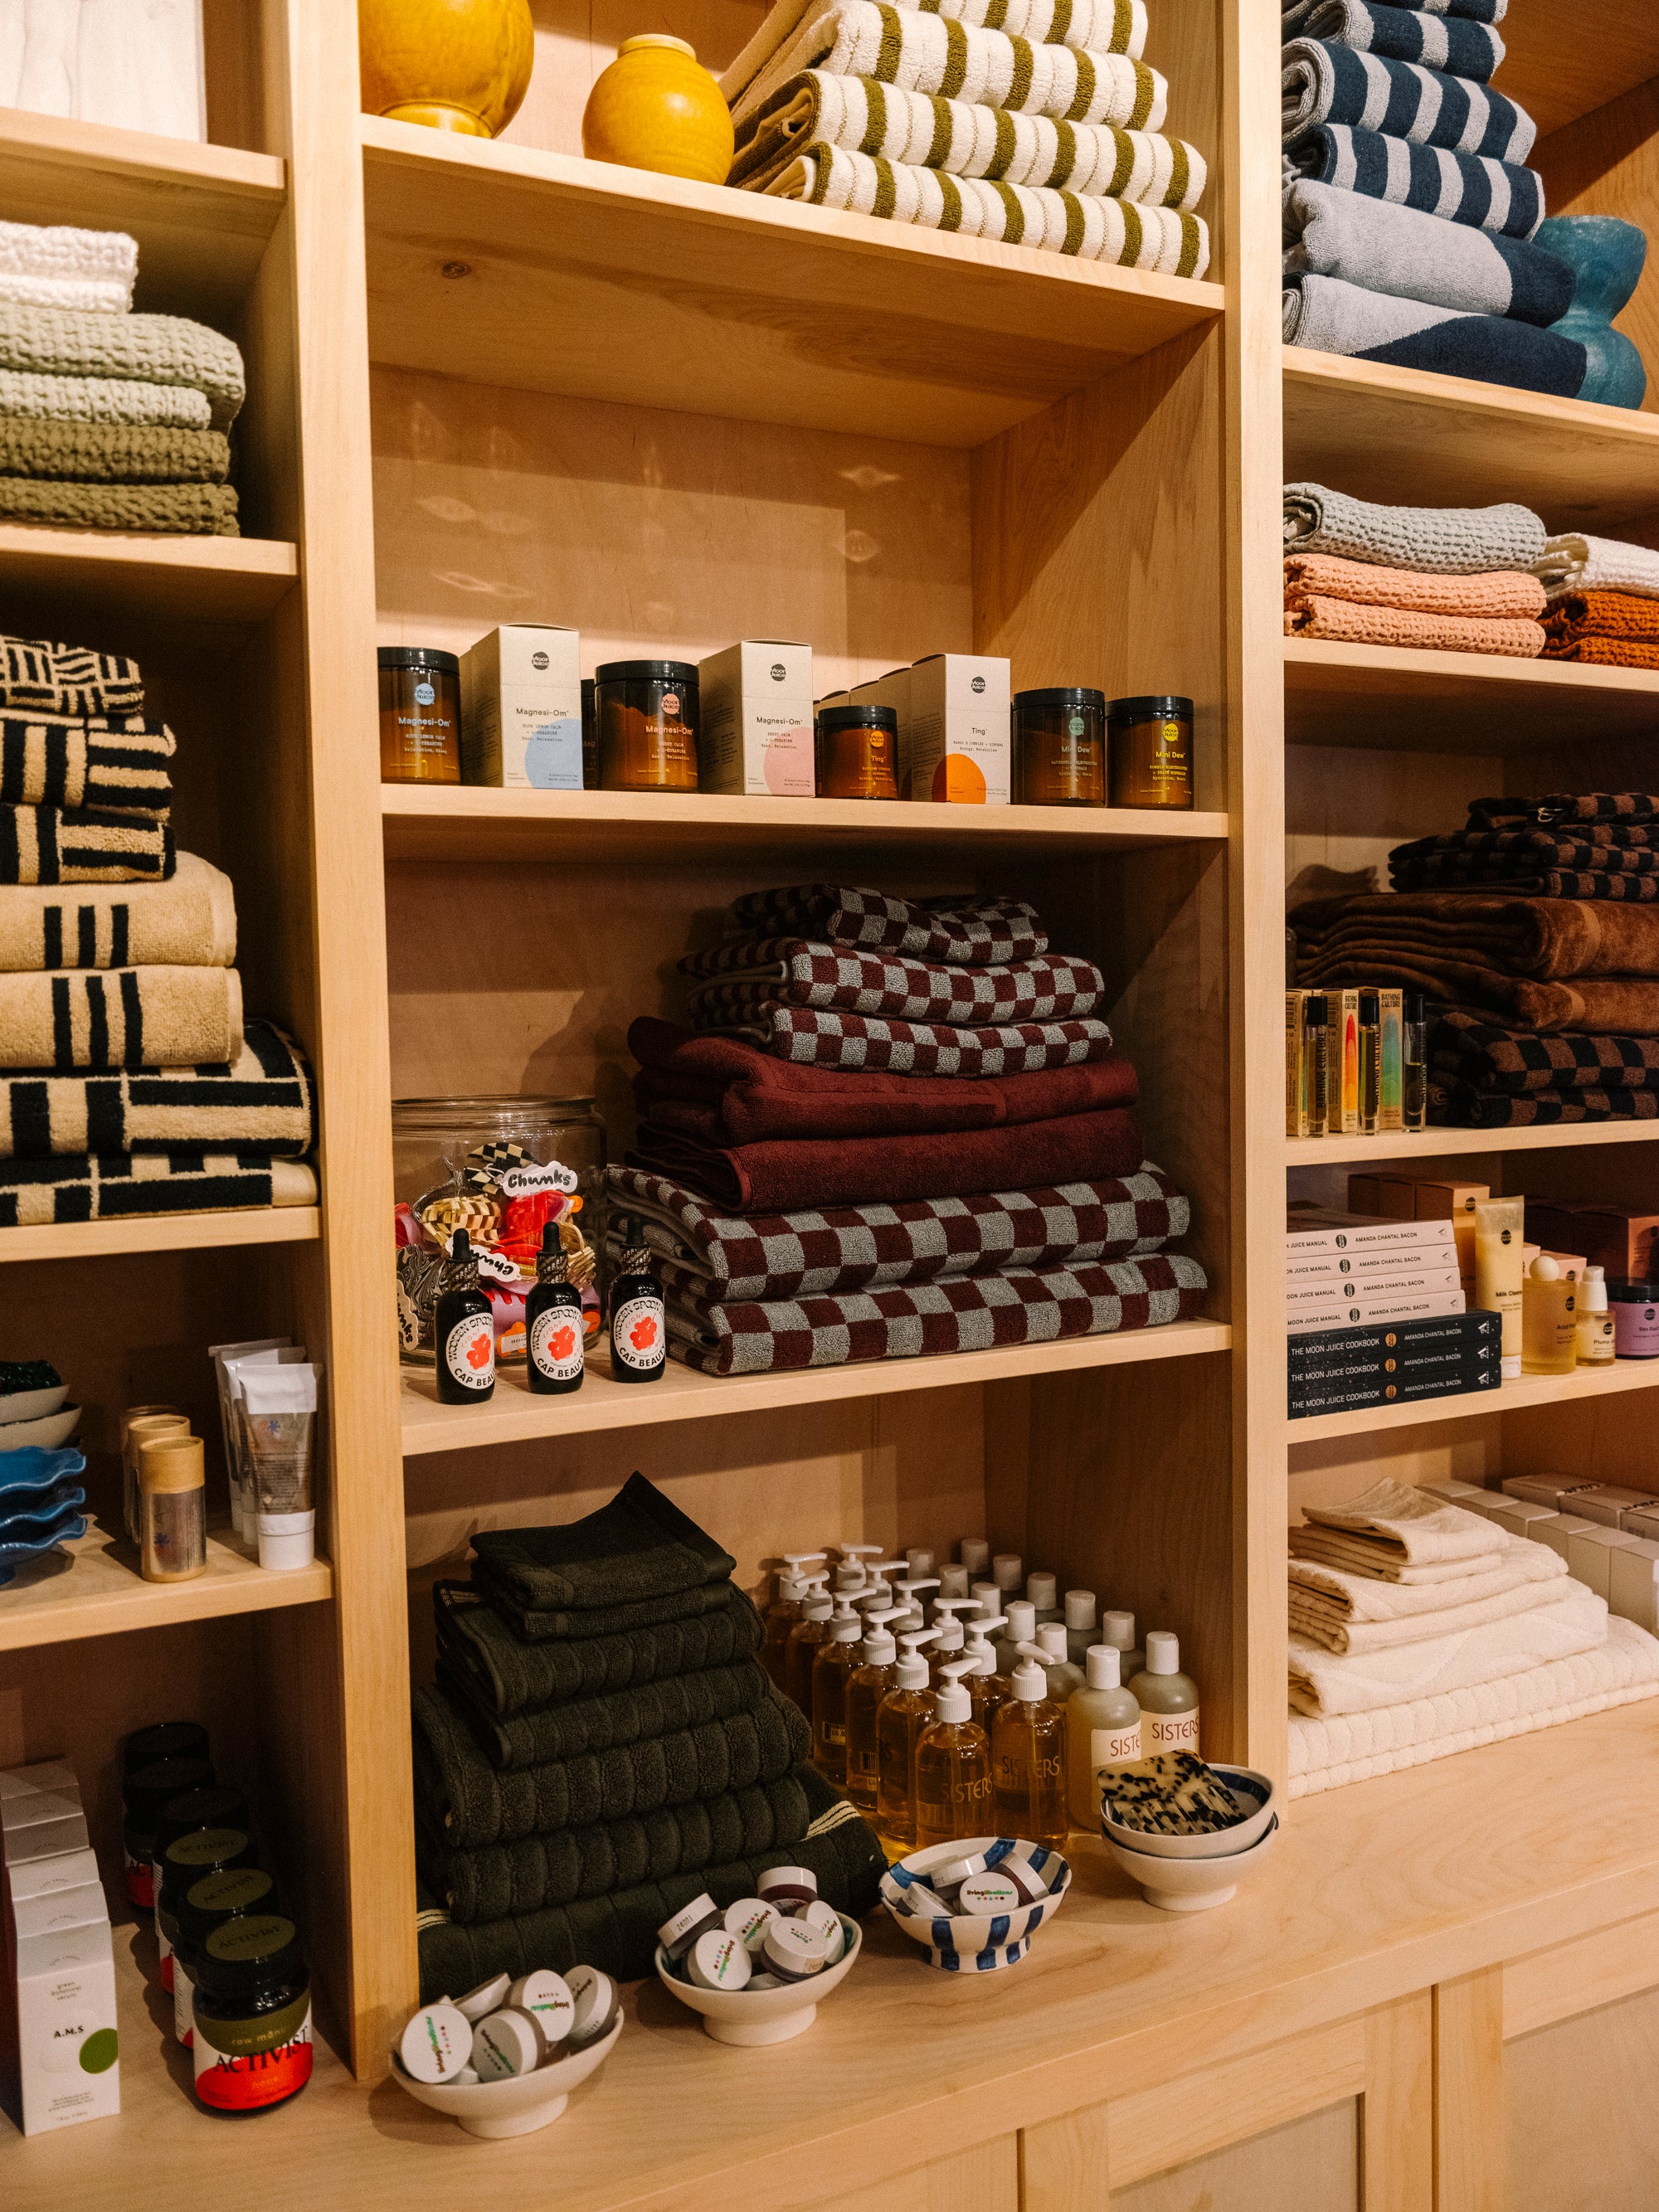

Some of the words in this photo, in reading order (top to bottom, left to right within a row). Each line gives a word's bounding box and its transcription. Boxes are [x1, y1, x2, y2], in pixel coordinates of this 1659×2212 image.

[516, 707, 569, 717] Magnesi-Om
[398, 716, 450, 727] Magnesi-Om
[756, 716, 803, 726] Magnesi-Om
[645, 725, 693, 736] Magnesi-Om
[971, 727, 987, 736] Ting
[871, 755, 887, 763] Ting
[1316, 1031, 1326, 1067] CULTURE
[1316, 1069, 1326, 1108] BATHING
[508, 1169, 572, 1189] Chunks
[1385, 1281, 1407, 1290] CHANTAL
[615, 1305, 634, 1340] WOODEN
[533, 1315, 551, 1351] WOODEN
[449, 1324, 469, 1362] WOODEN
[1291, 1347, 1304, 1356] THE
[1305, 1344, 1325, 1354] MOON
[1326, 1342, 1345, 1352] JUICE
[1345, 1338, 1380, 1349] COOKBOOK
[619, 1347, 636, 1363] CAP
[1424, 1355, 1445, 1364] CHANTAL
[537, 1358, 554, 1373] CAP
[1291, 1373, 1304, 1382] THE
[1305, 1371, 1325, 1380] MOON
[1326, 1369, 1345, 1378] JUICE
[1345, 1364, 1379, 1374] COOKBOOK
[455, 1368, 473, 1383] CAP
[1424, 1381, 1445, 1389] CHANTAL
[1292, 1401, 1305, 1409] THE
[1306, 1398, 1326, 1407] MOON
[1326, 1395, 1345, 1404] JUICE
[1345, 1390, 1380, 1402] COOKBOOK
[1152, 1715, 1199, 1741] SISTERS
[214, 2025, 309, 2073] ACTIVIST
